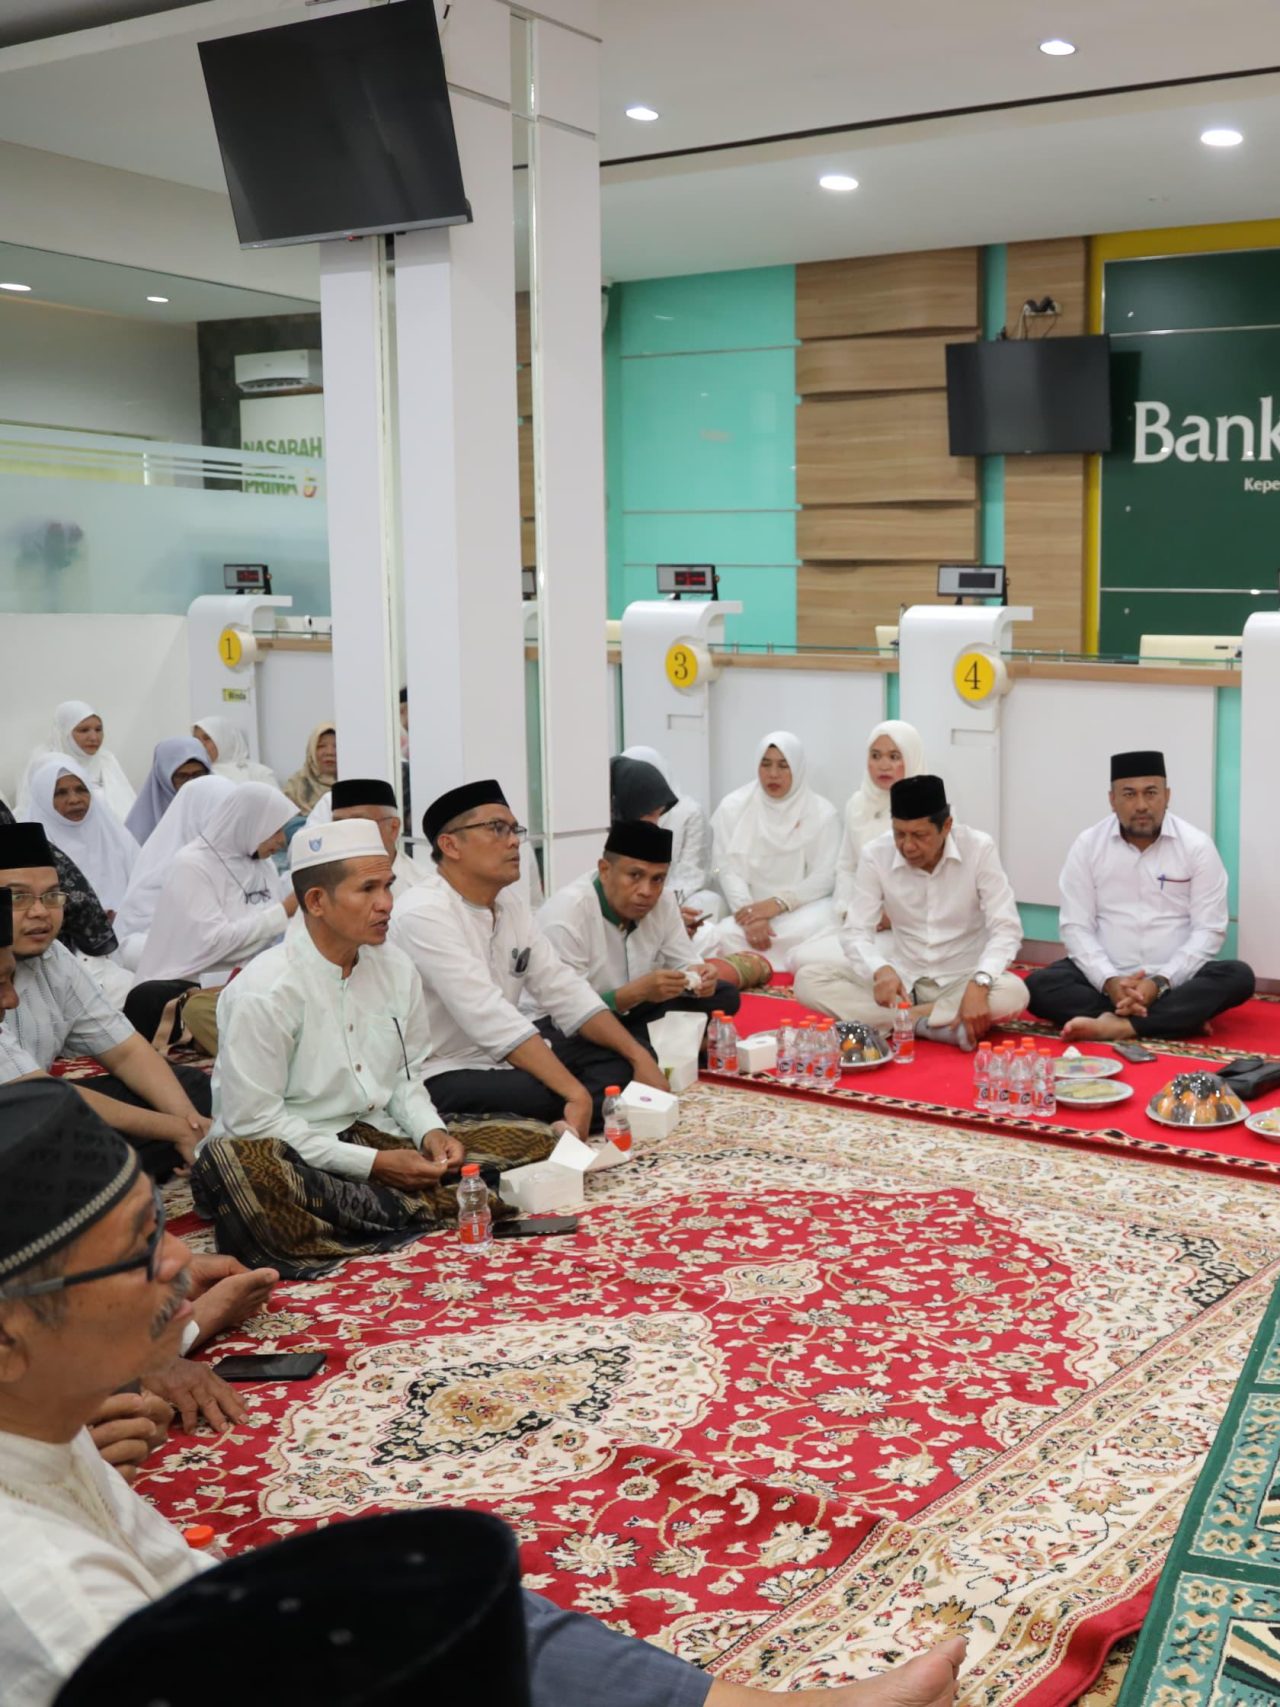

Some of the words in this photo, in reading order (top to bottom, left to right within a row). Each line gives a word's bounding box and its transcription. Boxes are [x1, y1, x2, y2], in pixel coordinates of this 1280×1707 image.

[225, 637, 234, 660] 1
[674, 651, 688, 680] 3
[964, 660, 982, 690] 4
